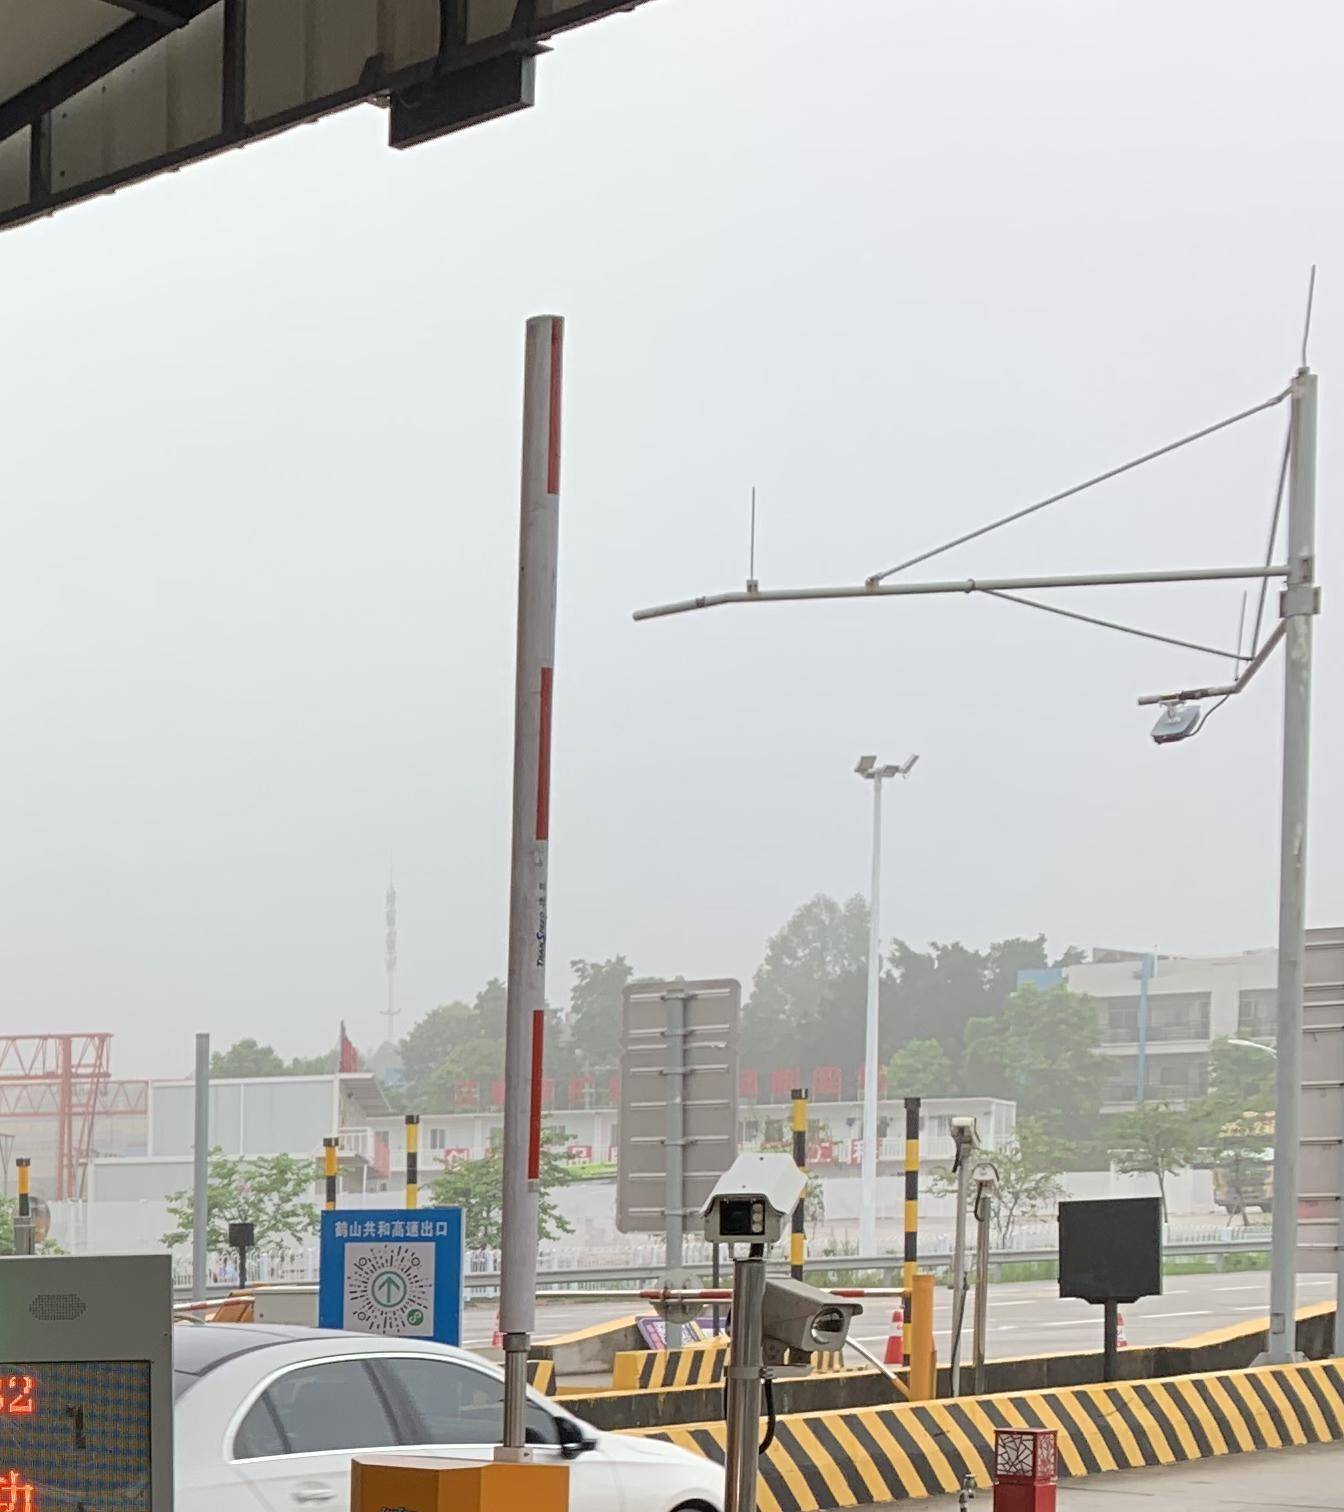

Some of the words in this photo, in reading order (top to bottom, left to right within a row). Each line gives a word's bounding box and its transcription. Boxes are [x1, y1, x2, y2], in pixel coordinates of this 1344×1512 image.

[334, 1220, 448, 1239] 鹤山共和高速出口
